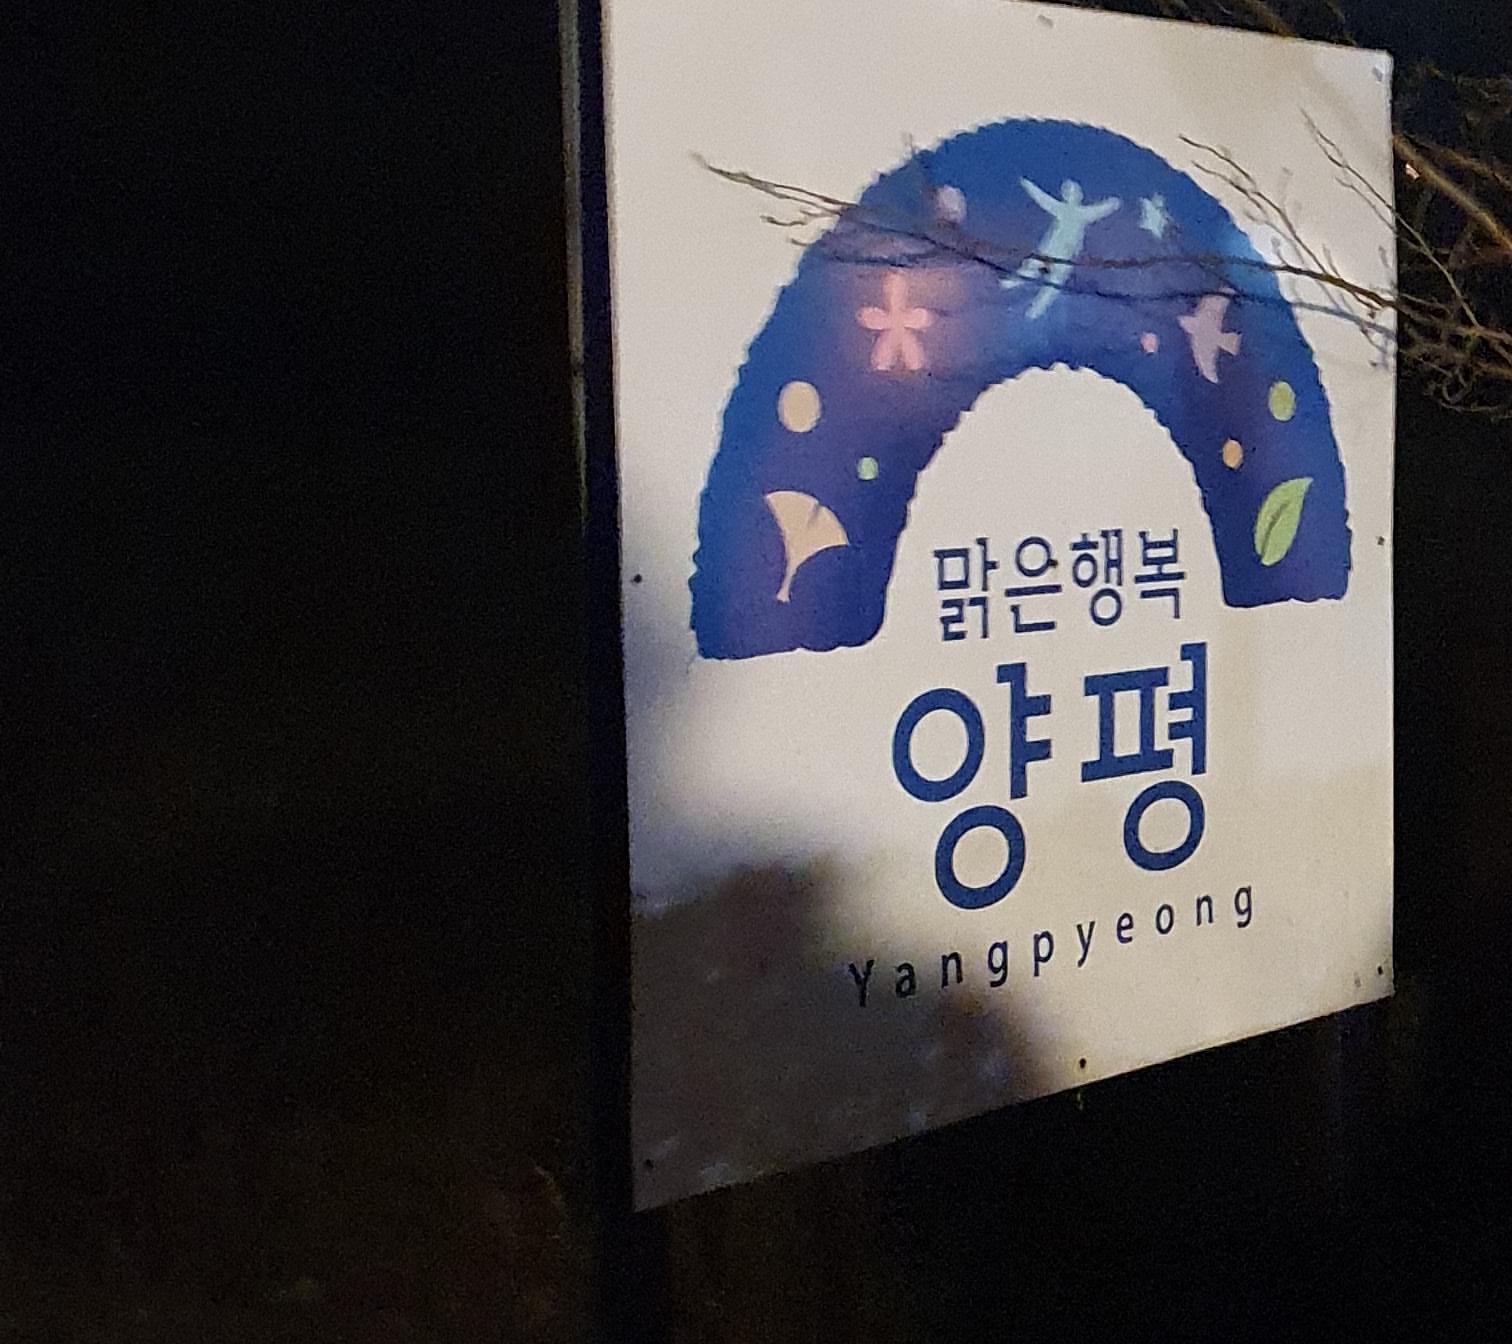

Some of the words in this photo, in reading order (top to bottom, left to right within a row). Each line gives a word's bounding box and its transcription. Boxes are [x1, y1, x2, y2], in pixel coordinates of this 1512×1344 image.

[933, 527, 1187, 641] 맑은행복
[892, 642, 1207, 910] 양평
[848, 884, 1254, 1007] Yangpyeong
